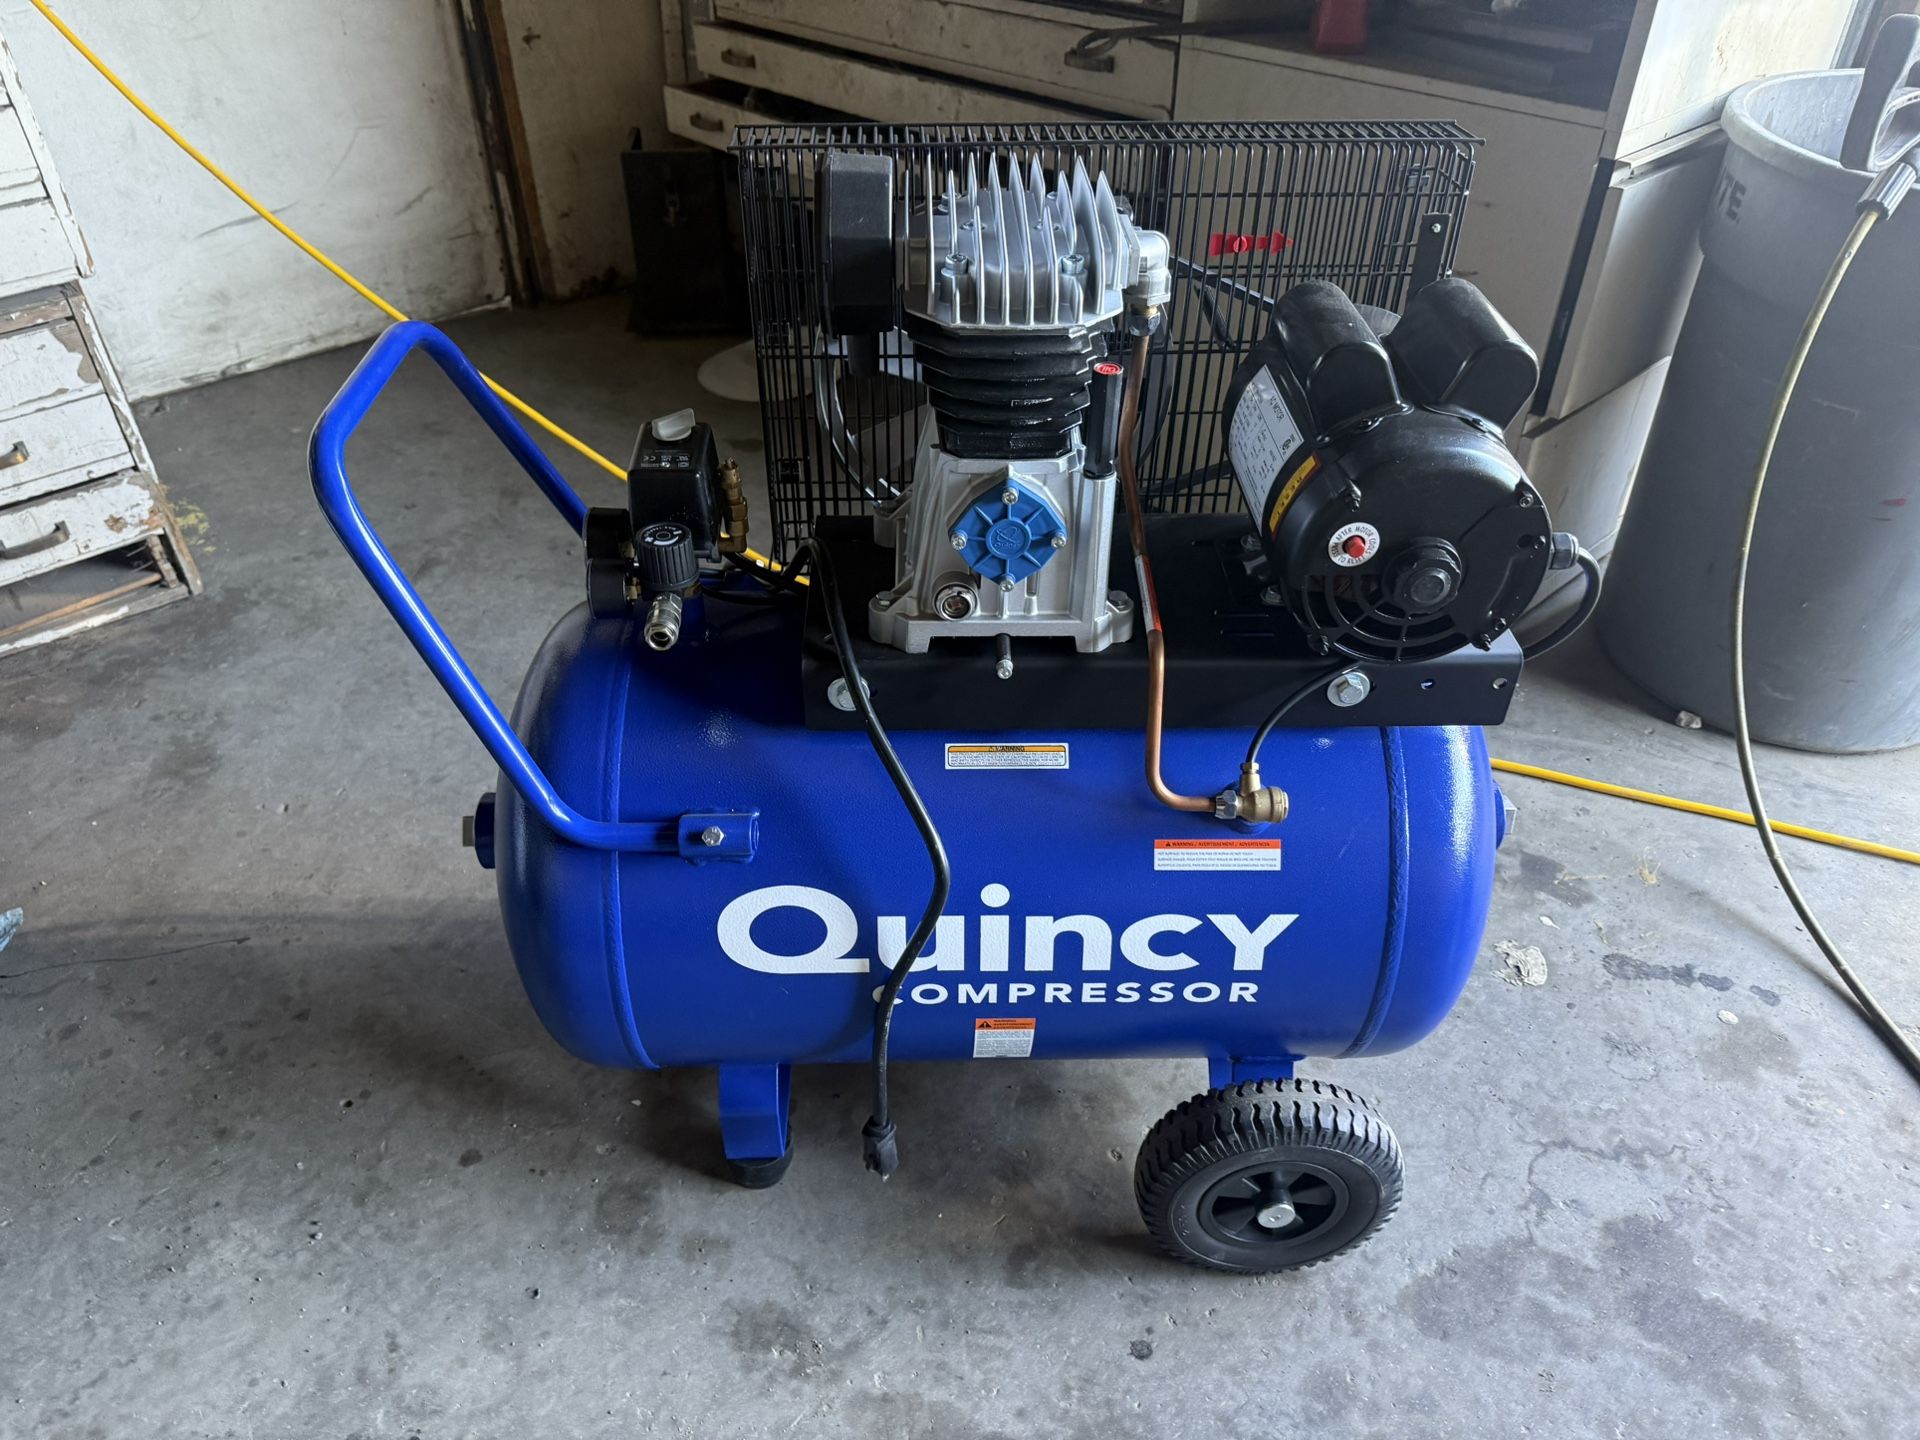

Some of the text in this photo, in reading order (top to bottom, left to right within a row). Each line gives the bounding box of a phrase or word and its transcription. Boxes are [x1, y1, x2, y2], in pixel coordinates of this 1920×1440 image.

[1335, 525, 1378, 555] AFTER MOTOR COOLS
[1337, 555, 1347, 563] TO
[1347, 554, 1368, 565] RESET
